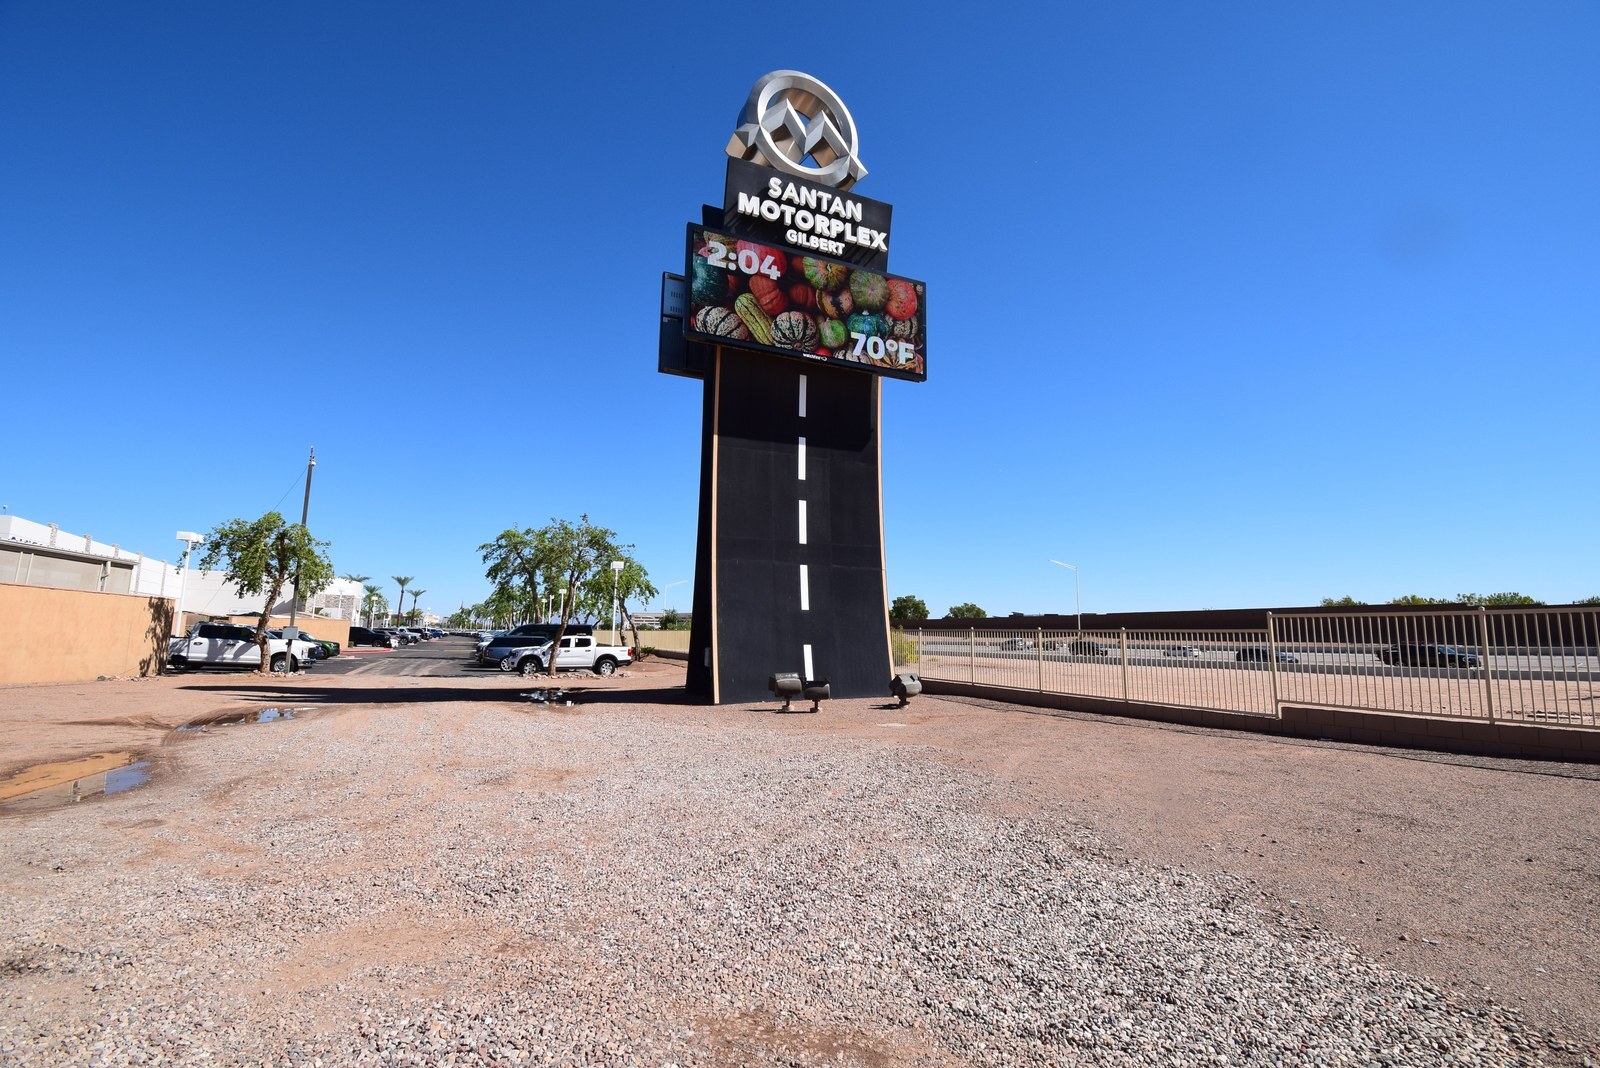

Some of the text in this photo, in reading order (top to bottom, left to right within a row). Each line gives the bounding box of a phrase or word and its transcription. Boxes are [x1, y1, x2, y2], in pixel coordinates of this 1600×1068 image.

[768, 177, 862, 222] SANTAN
[738, 192, 888, 251] MOTORPLEX
[707, 240, 781, 280] 2:04
[785, 229, 845, 256] GILBERT
[850, 331, 915, 365] 70°F
